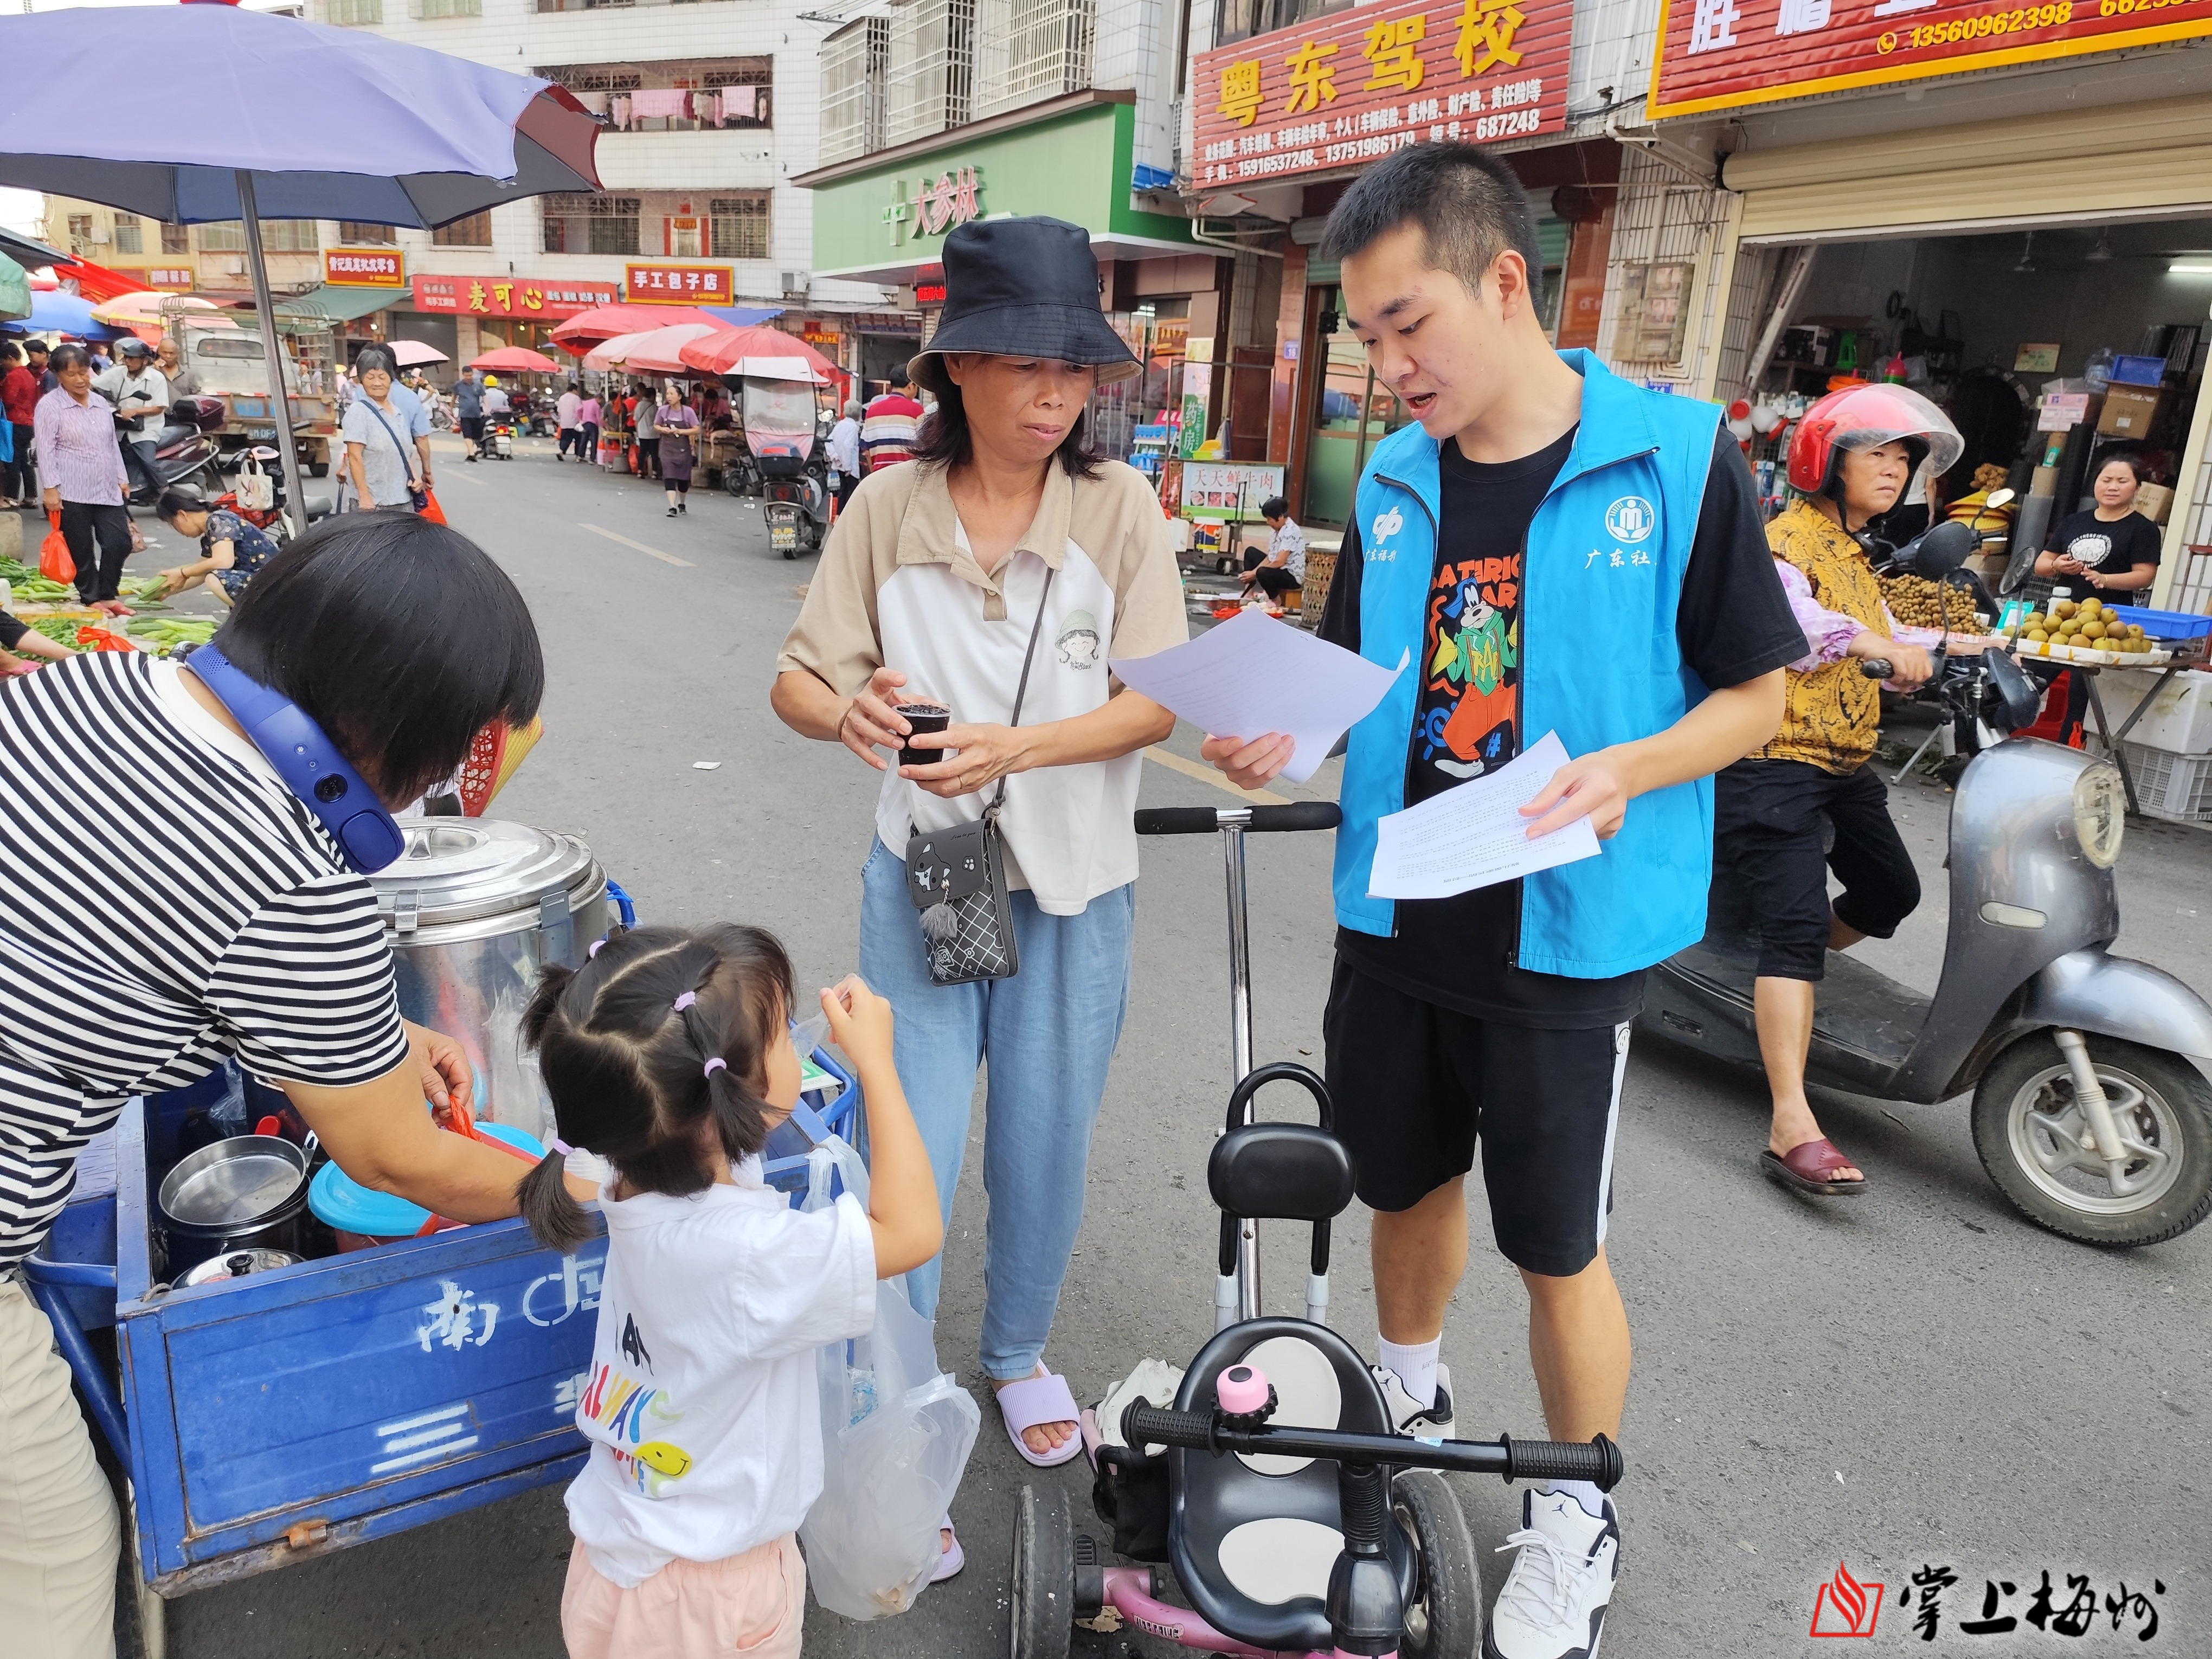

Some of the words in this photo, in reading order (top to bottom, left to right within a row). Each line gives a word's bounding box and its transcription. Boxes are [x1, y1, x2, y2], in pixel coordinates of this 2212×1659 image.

[1909, 4, 2072, 48] 13560962398
[1216, 0, 1527, 126] 粤东驾校
[1476, 108, 1540, 140] 687248
[909, 165, 979, 239] 大参林
[468, 280, 543, 313] 麦可心
[634, 271, 718, 291] 手工包子店
[1193, 468, 1273, 490] 天天鲜牛肉
[1364, 548, 1397, 563] 广东福彩
[1584, 548, 1657, 569] 广东社
